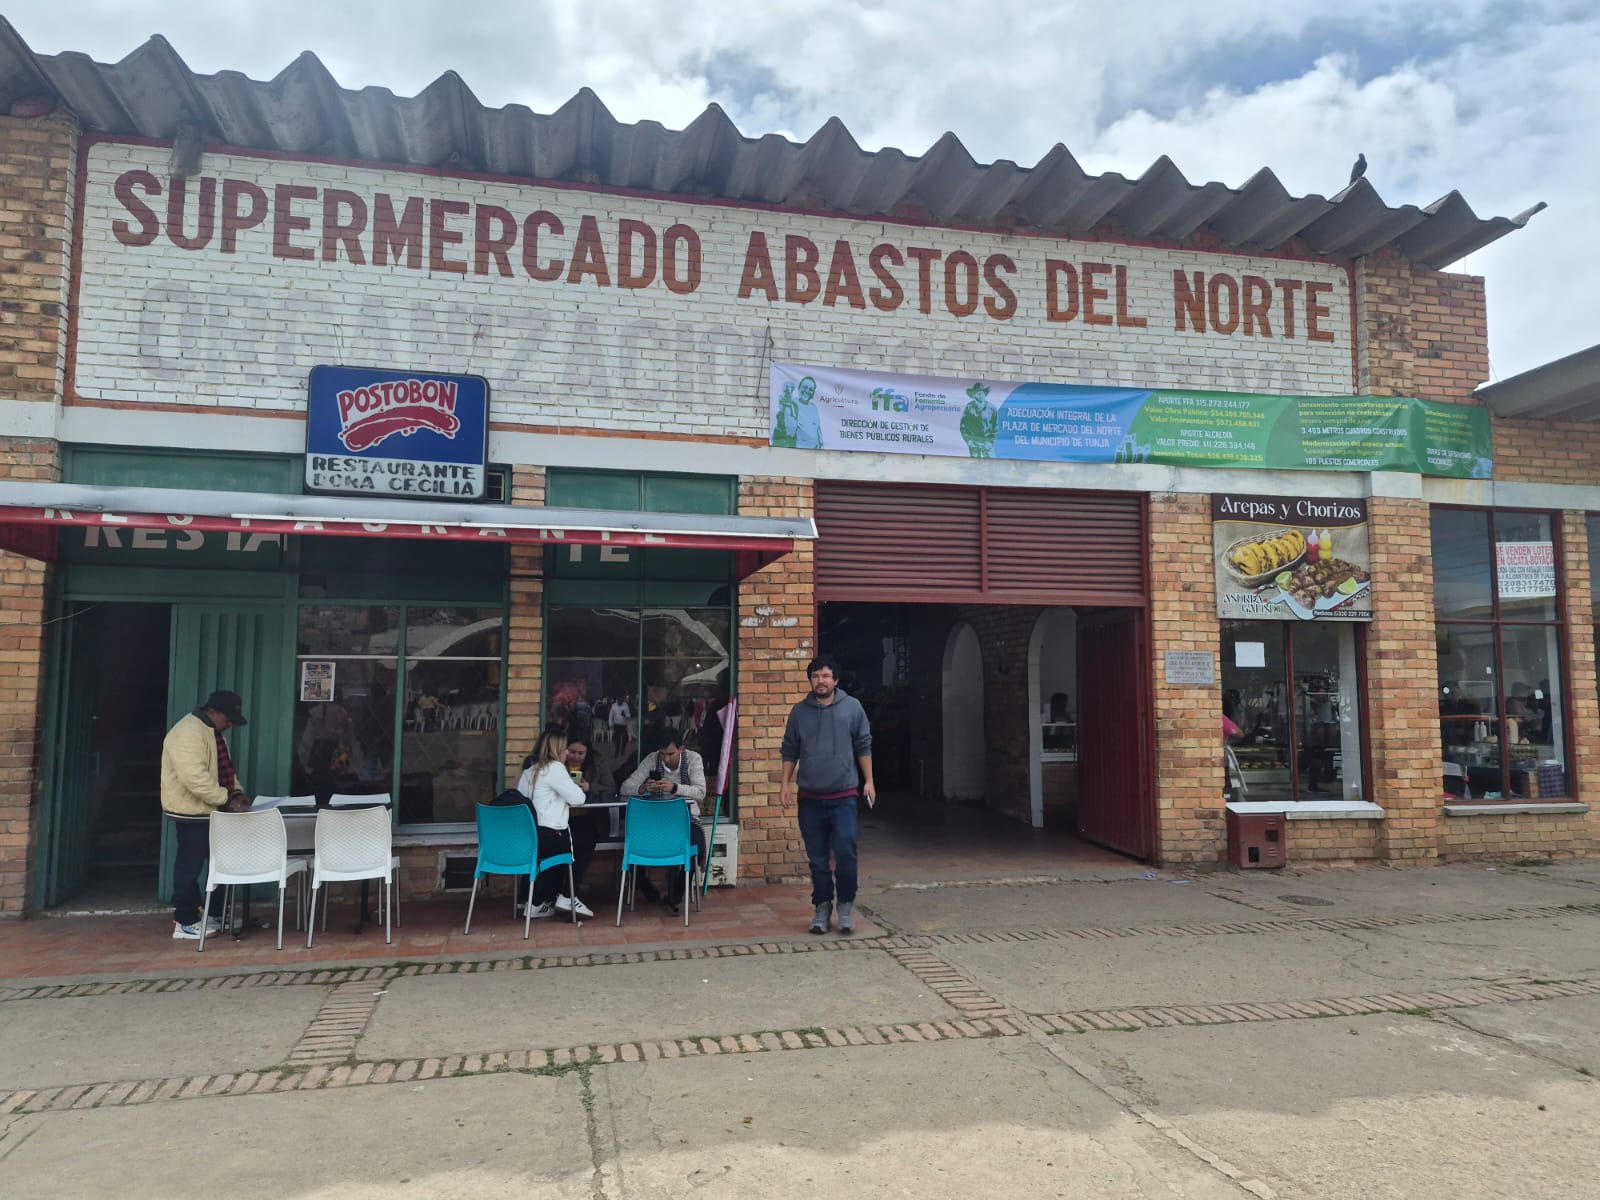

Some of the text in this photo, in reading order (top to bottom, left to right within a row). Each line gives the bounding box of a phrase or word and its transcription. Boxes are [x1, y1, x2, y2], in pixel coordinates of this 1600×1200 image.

[112, 169, 1335, 343] SUPERMERCADO ABASTOS DEL NORTE
[337, 380, 458, 423] POSTOBON
[870, 387, 909, 413] ffa
[914, 397, 946, 405] Fomento
[914, 403, 961, 413] Agropecuario
[1007, 407, 1117, 423] ADECUACIÓN INTEGRAL DE LA
[840, 417, 929, 433] DIRECCIÓN DE GESTIÓN DE
[1002, 421, 1122, 437] PLAZA DE MERCADO DEL NORTE
[840, 430, 935, 444] BIENES PÚBLICOS RURALES
[1014, 435, 1110, 448] DEL MUNICIPIO DE TUNJA
[312, 457, 476, 481] RESTAURANTE
[389, 477, 475, 496] CECILIA
[1220, 496, 1361, 520] Arepas y Chorizos
[1505, 545, 1531, 555] VENDEN
